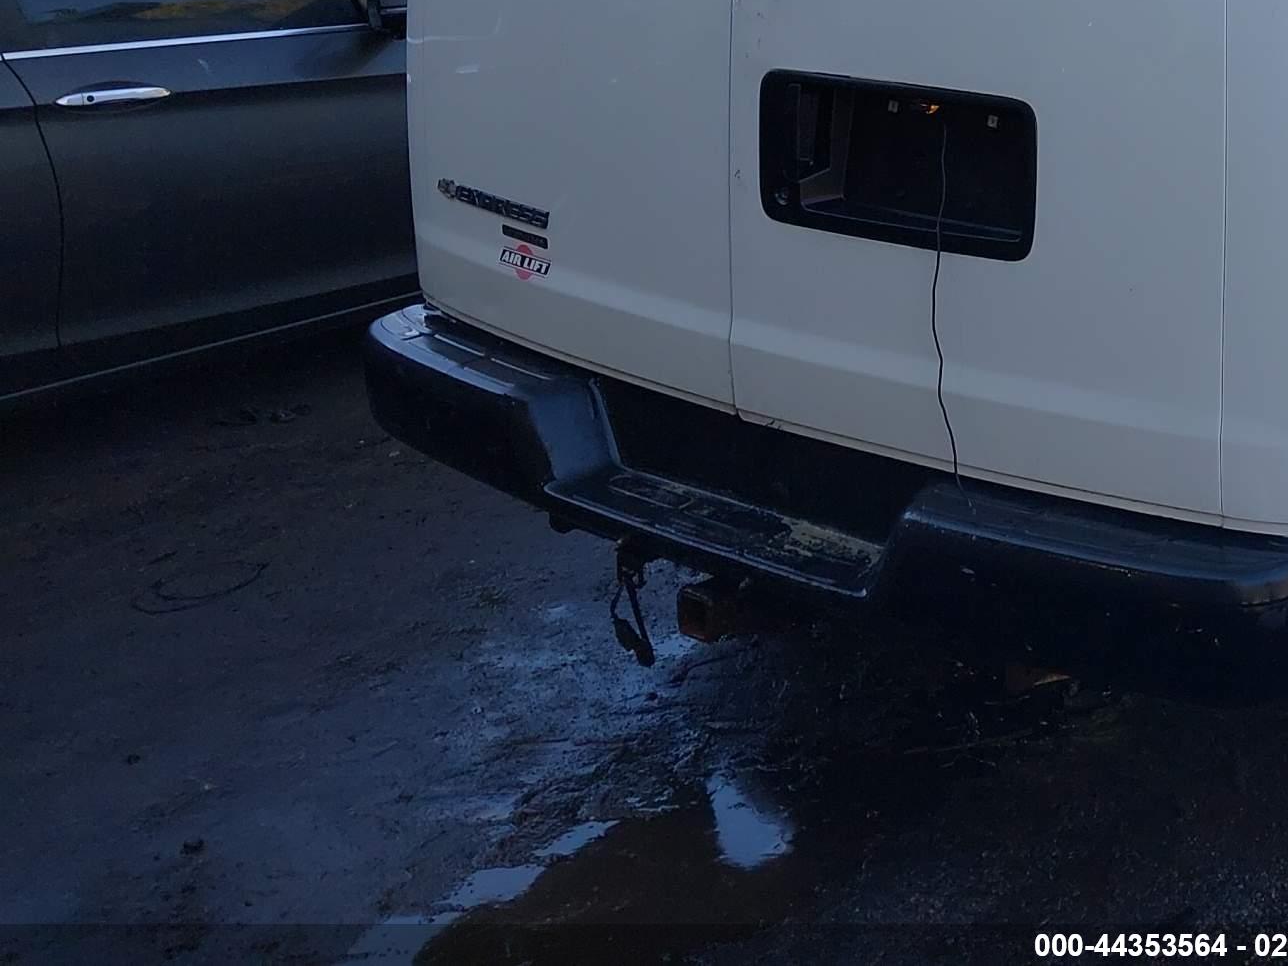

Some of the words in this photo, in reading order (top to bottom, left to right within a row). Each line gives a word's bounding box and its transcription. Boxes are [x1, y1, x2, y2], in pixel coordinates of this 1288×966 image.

[455, 185, 550, 230] EXPRESS
[501, 250, 522, 268] AIR
[523, 256, 549, 274] LIFT
